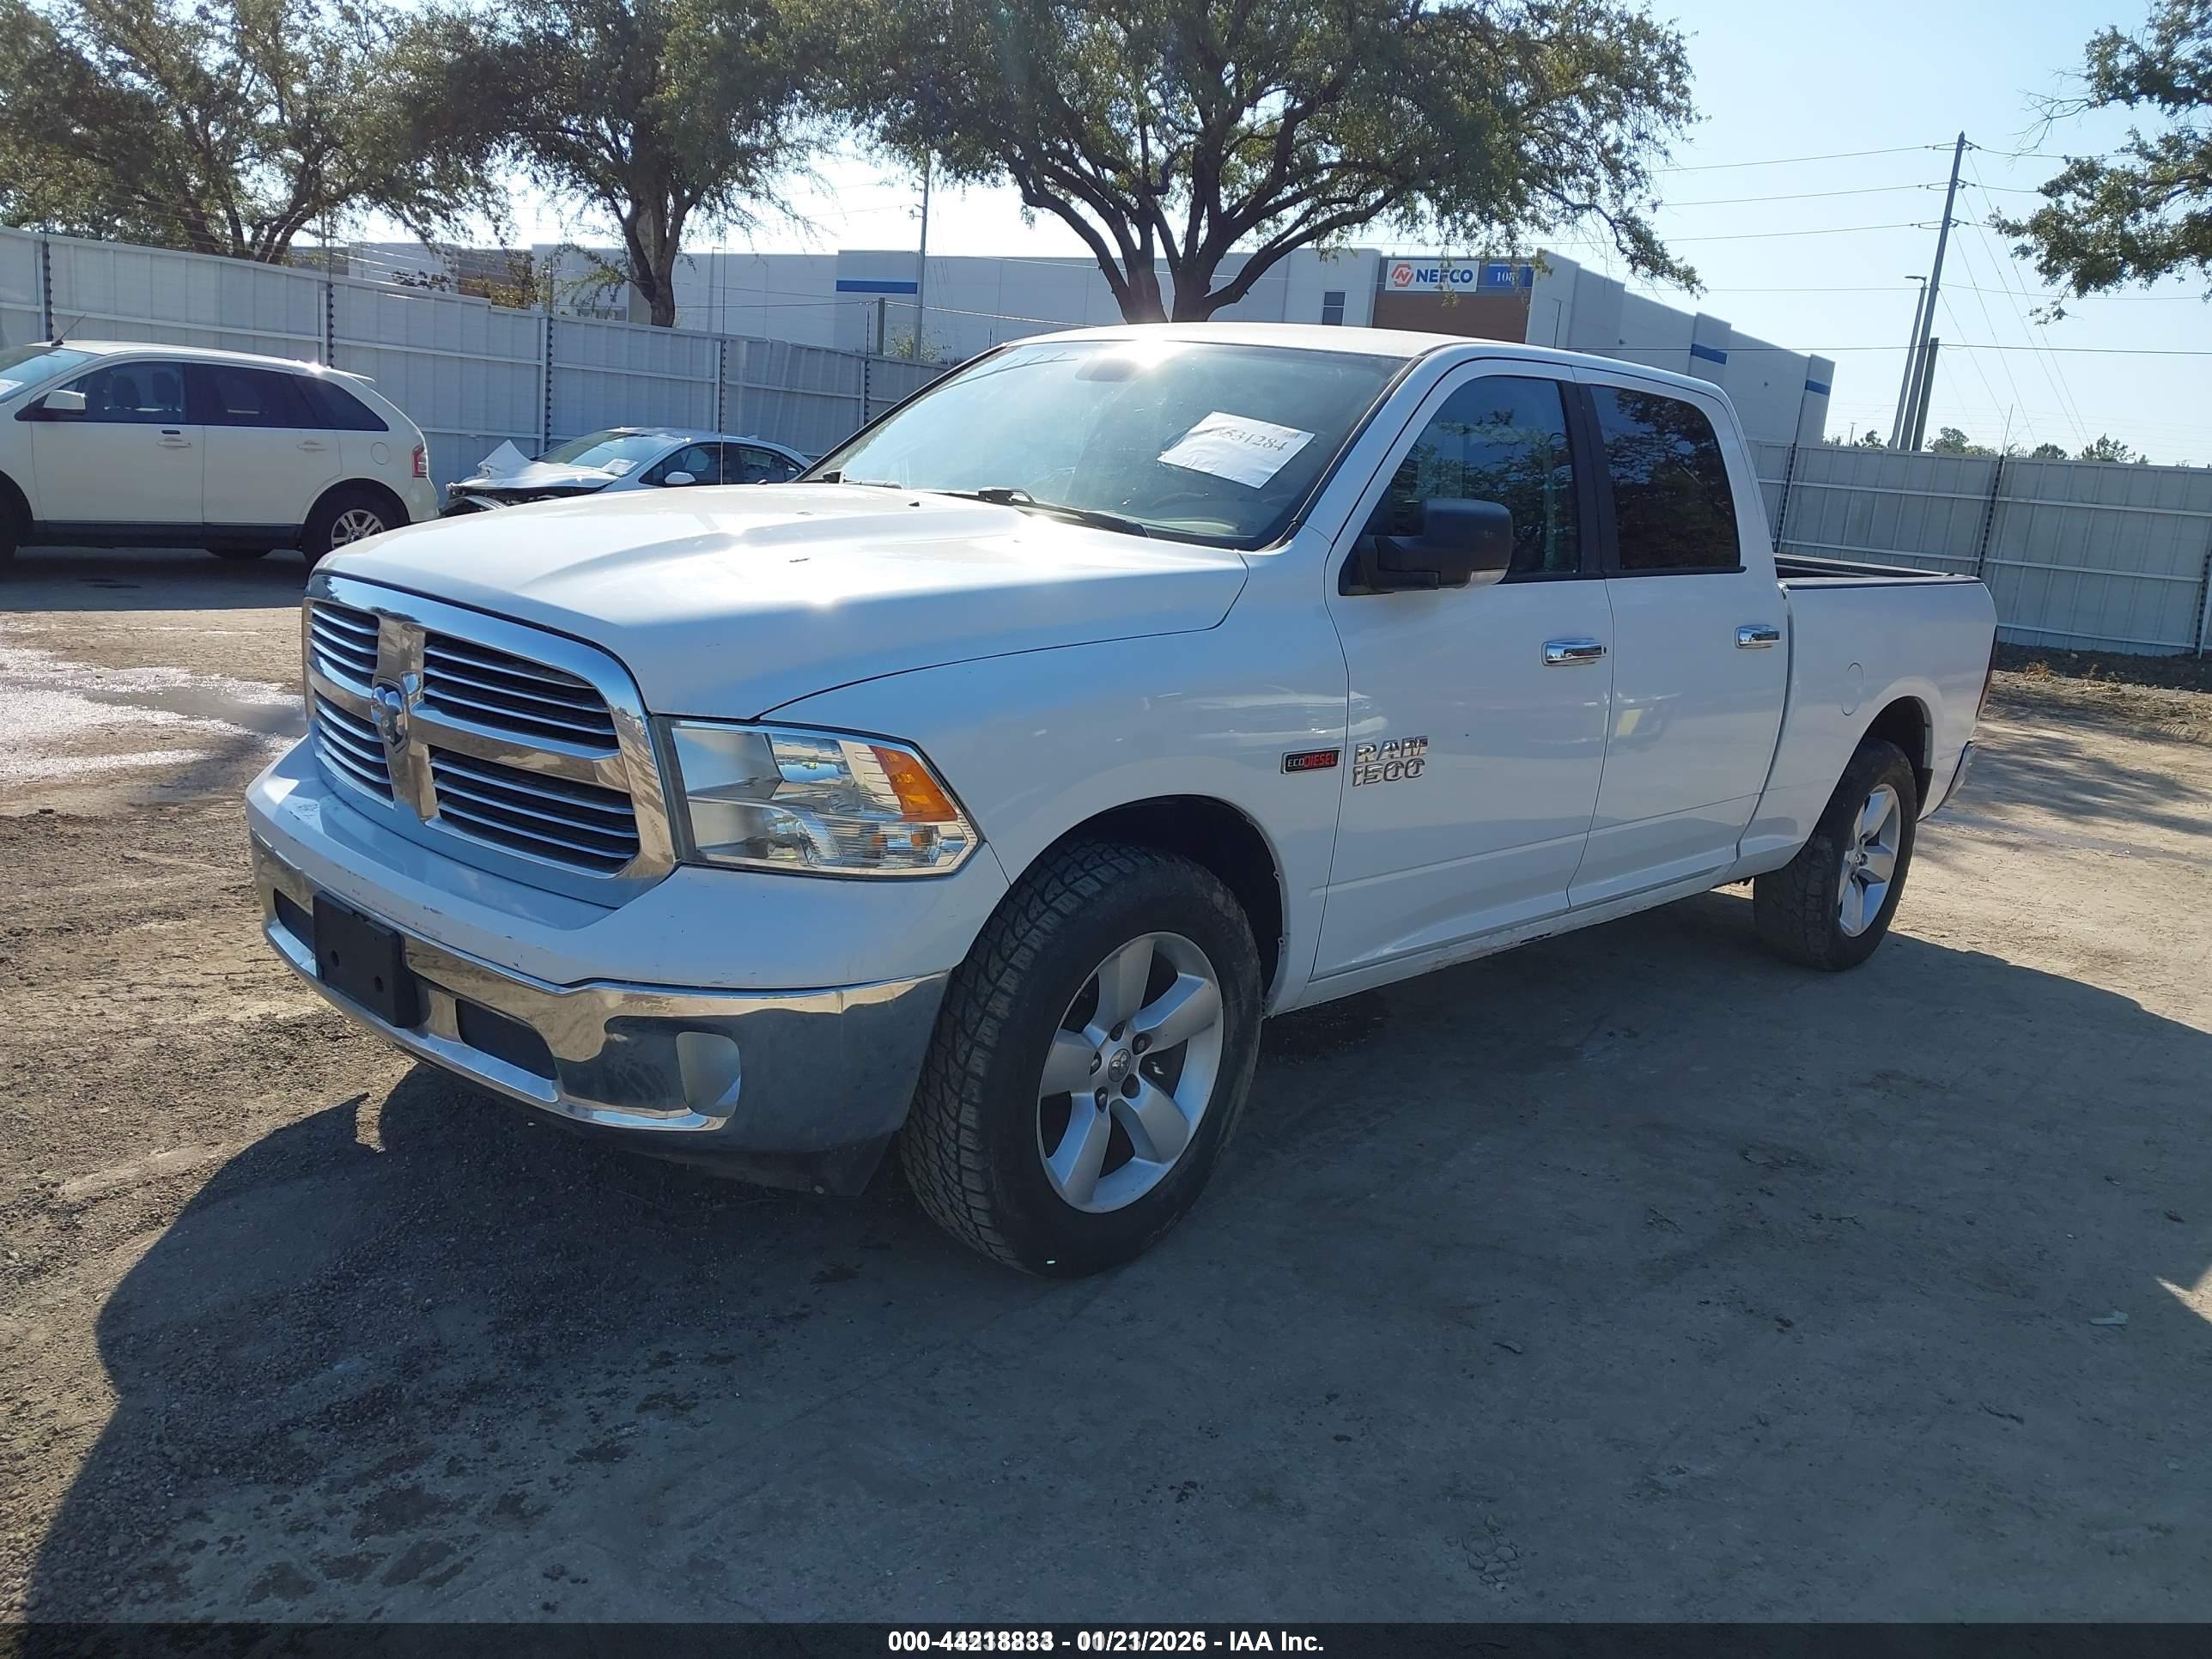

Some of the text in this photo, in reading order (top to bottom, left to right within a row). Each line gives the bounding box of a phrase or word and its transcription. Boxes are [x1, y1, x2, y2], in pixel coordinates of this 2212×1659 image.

[1415, 268, 1474, 283] NEFCO
[1287, 752, 1336, 768] ECODIESEL
[1354, 736, 1429, 764] RAM
[1352, 758, 1425, 787] 1500
